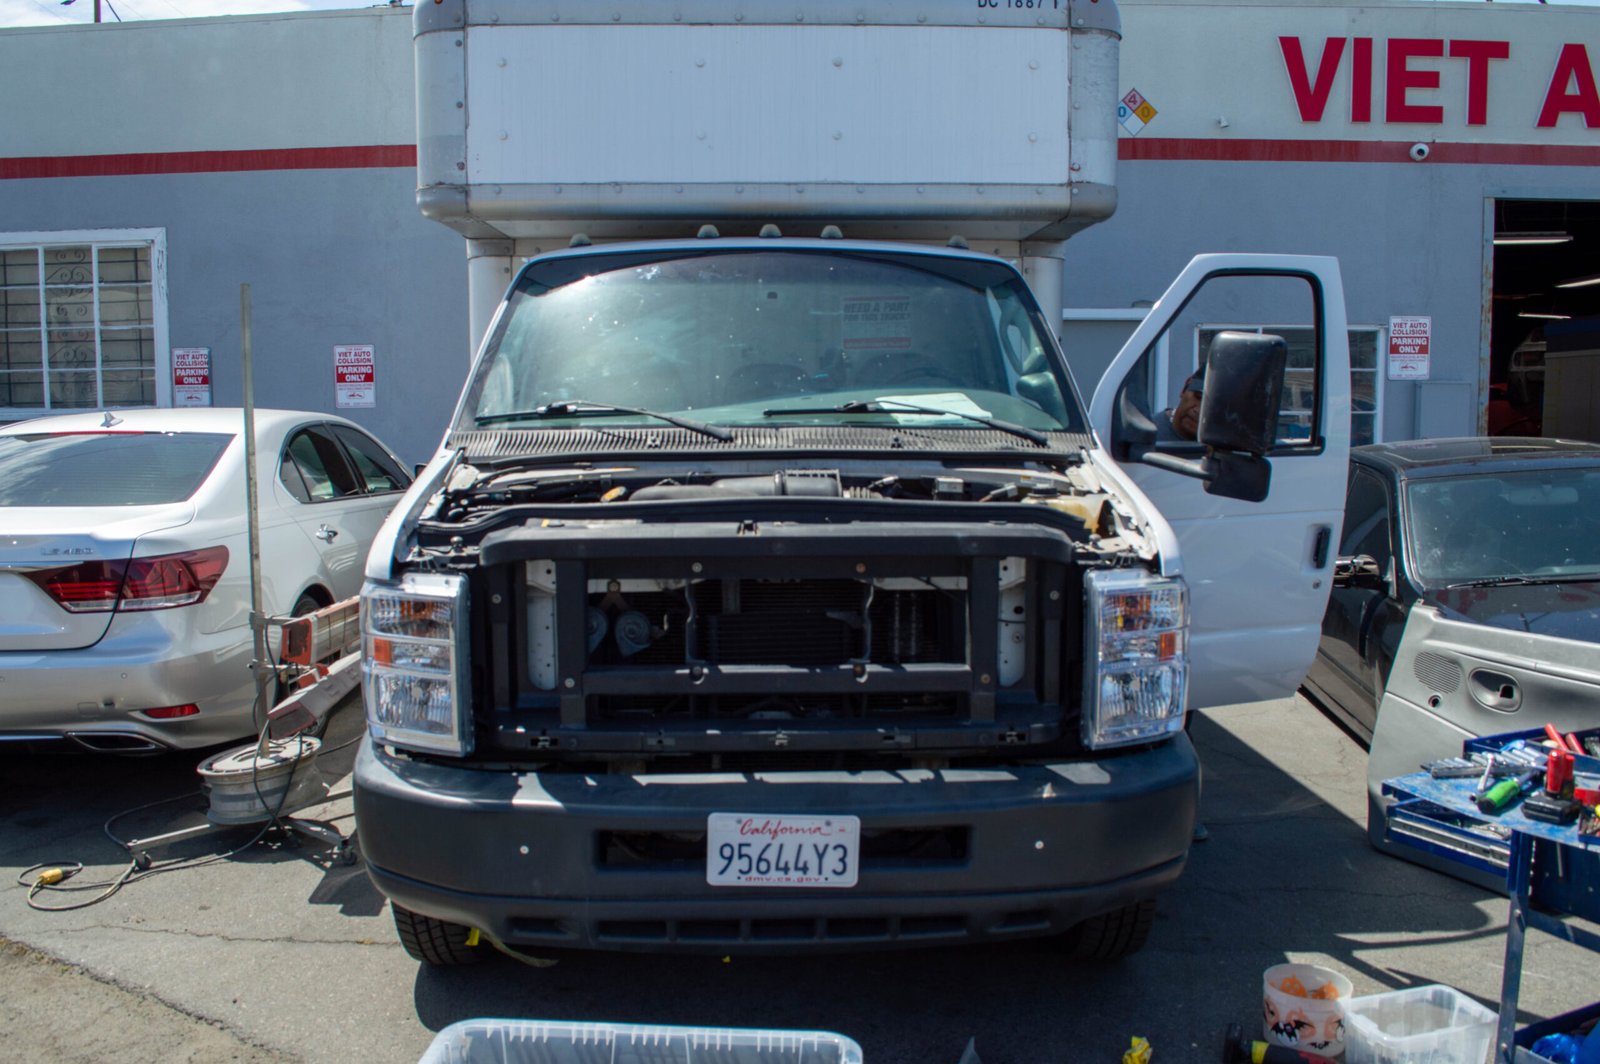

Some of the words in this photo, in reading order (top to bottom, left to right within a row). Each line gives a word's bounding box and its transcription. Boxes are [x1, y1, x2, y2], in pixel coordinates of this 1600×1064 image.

[1277, 36, 1510, 126] VIET
[1128, 93, 1137, 105] 4
[338, 366, 372, 374] PARKING
[740, 818, 832, 840] California
[717, 842, 848, 876] 95644Y3
